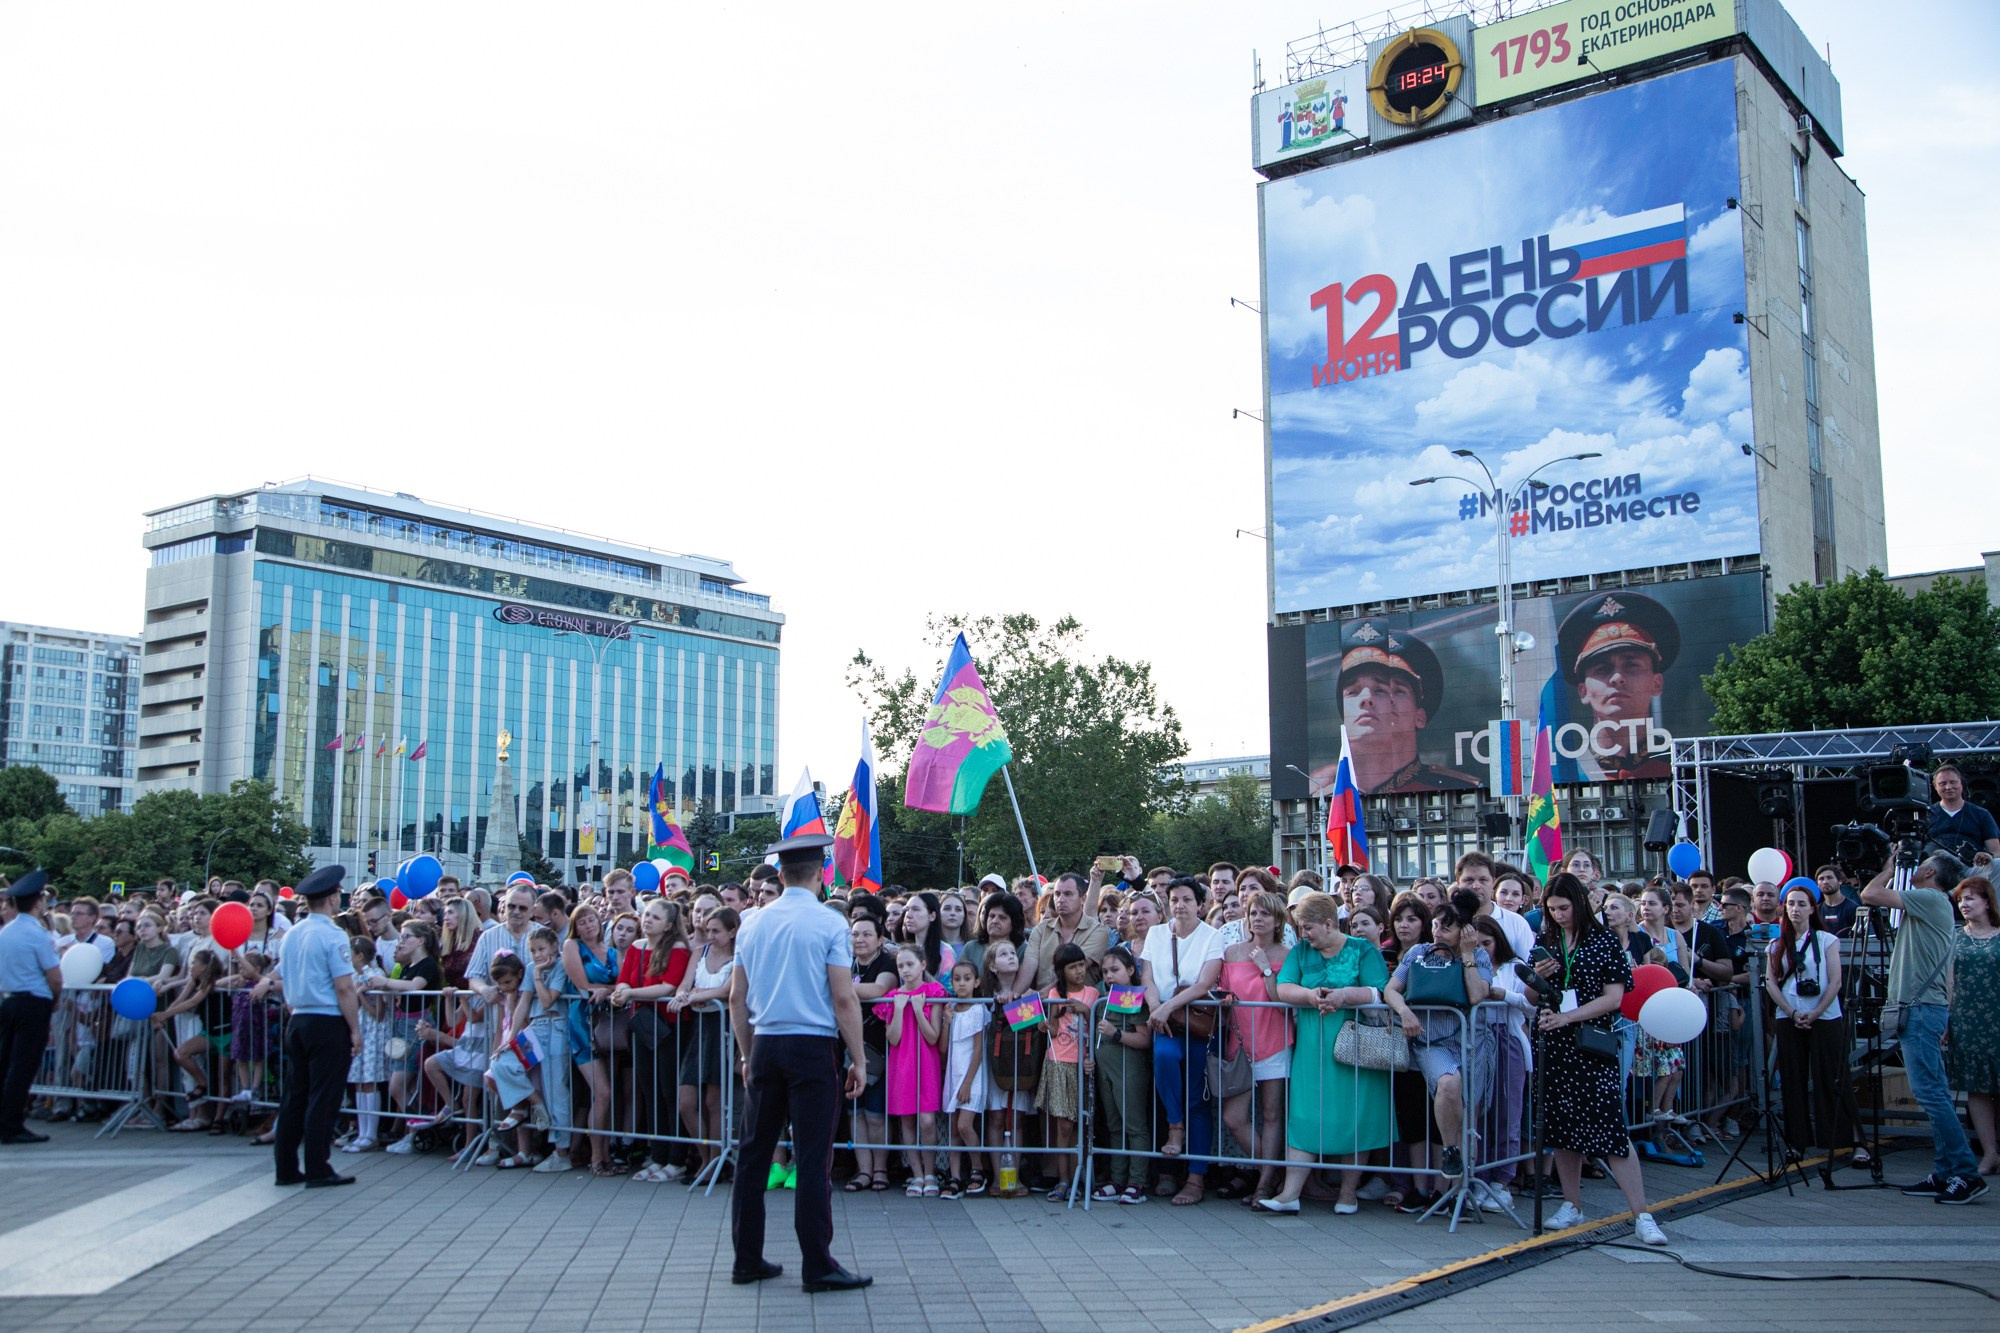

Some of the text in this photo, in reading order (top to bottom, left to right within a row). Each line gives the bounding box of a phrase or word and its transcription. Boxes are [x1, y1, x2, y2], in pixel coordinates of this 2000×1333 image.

[1580, 10, 1611, 33] ГОД
[1581, 2, 1716, 56] ЕКАТЕРИНОДАРА
[1490, 22, 1572, 79] 1793
[1401, 63, 1445, 90] 19:24
[1310, 233, 1582, 362] 12 ДЕНЬ
[1311, 256, 1689, 389] ИЮНЯ РОССИИ
[1458, 472, 1642, 521] #МыРоссия
[1510, 490, 1701, 538] #МыВместе
[537, 610, 633, 641] CROWNE PLAZA
[1454, 716, 1673, 767] ГООСТЬ
